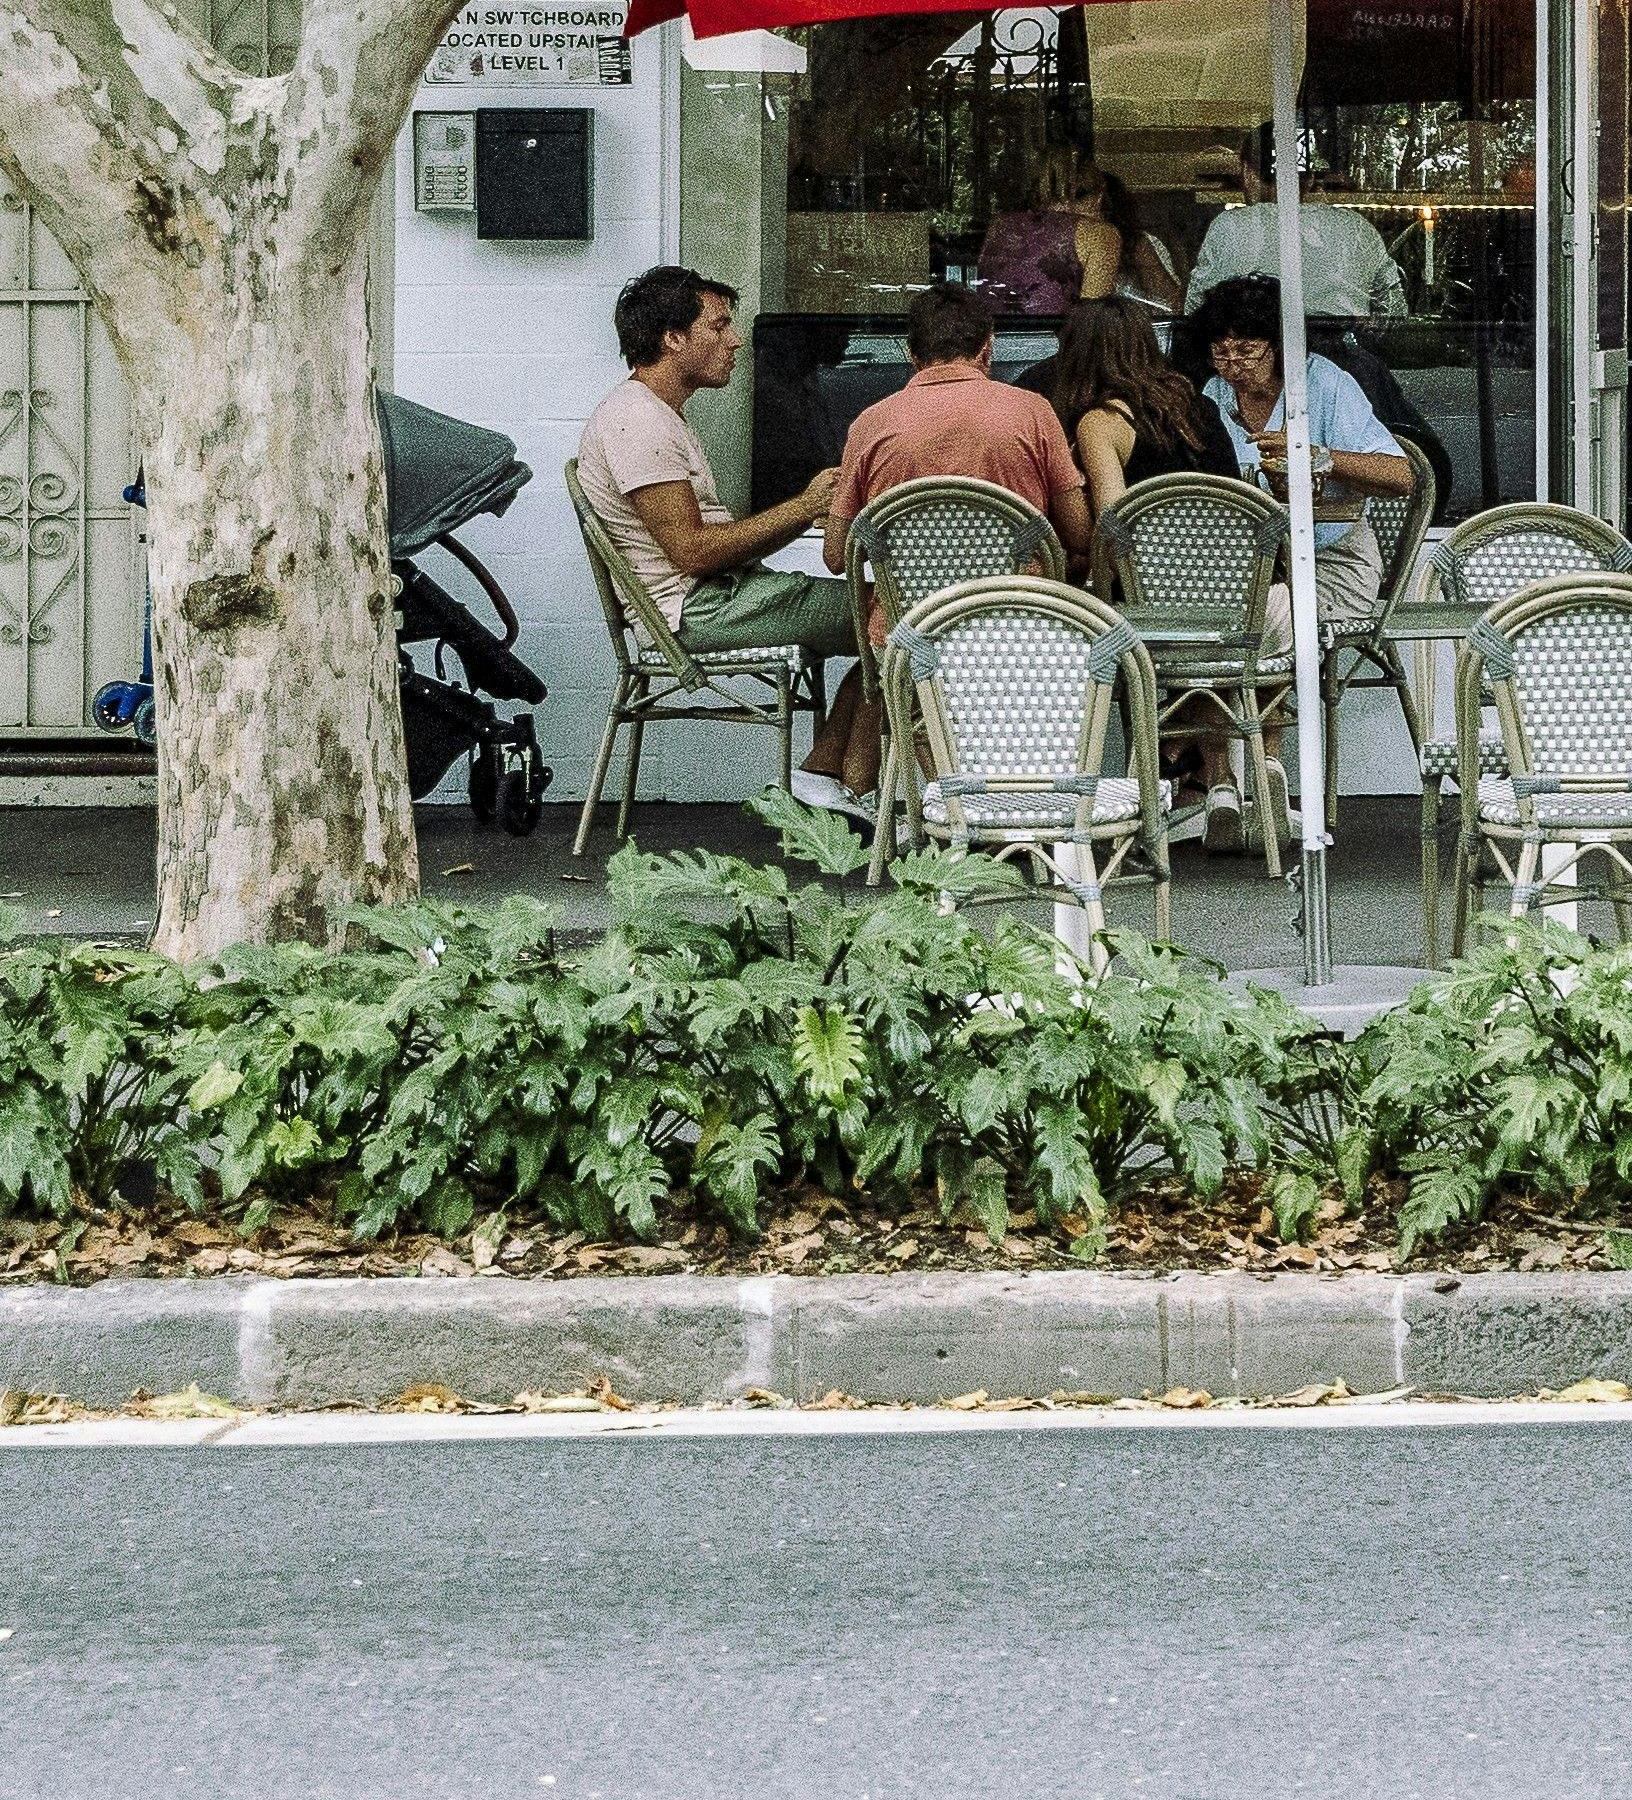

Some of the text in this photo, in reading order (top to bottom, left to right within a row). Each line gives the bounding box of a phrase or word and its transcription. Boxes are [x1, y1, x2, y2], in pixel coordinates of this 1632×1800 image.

[484, 11, 625, 27] SWTCHBOARD
[529, 33, 597, 49] UPSTAI
[491, 55, 563, 71] LEVEL 1
